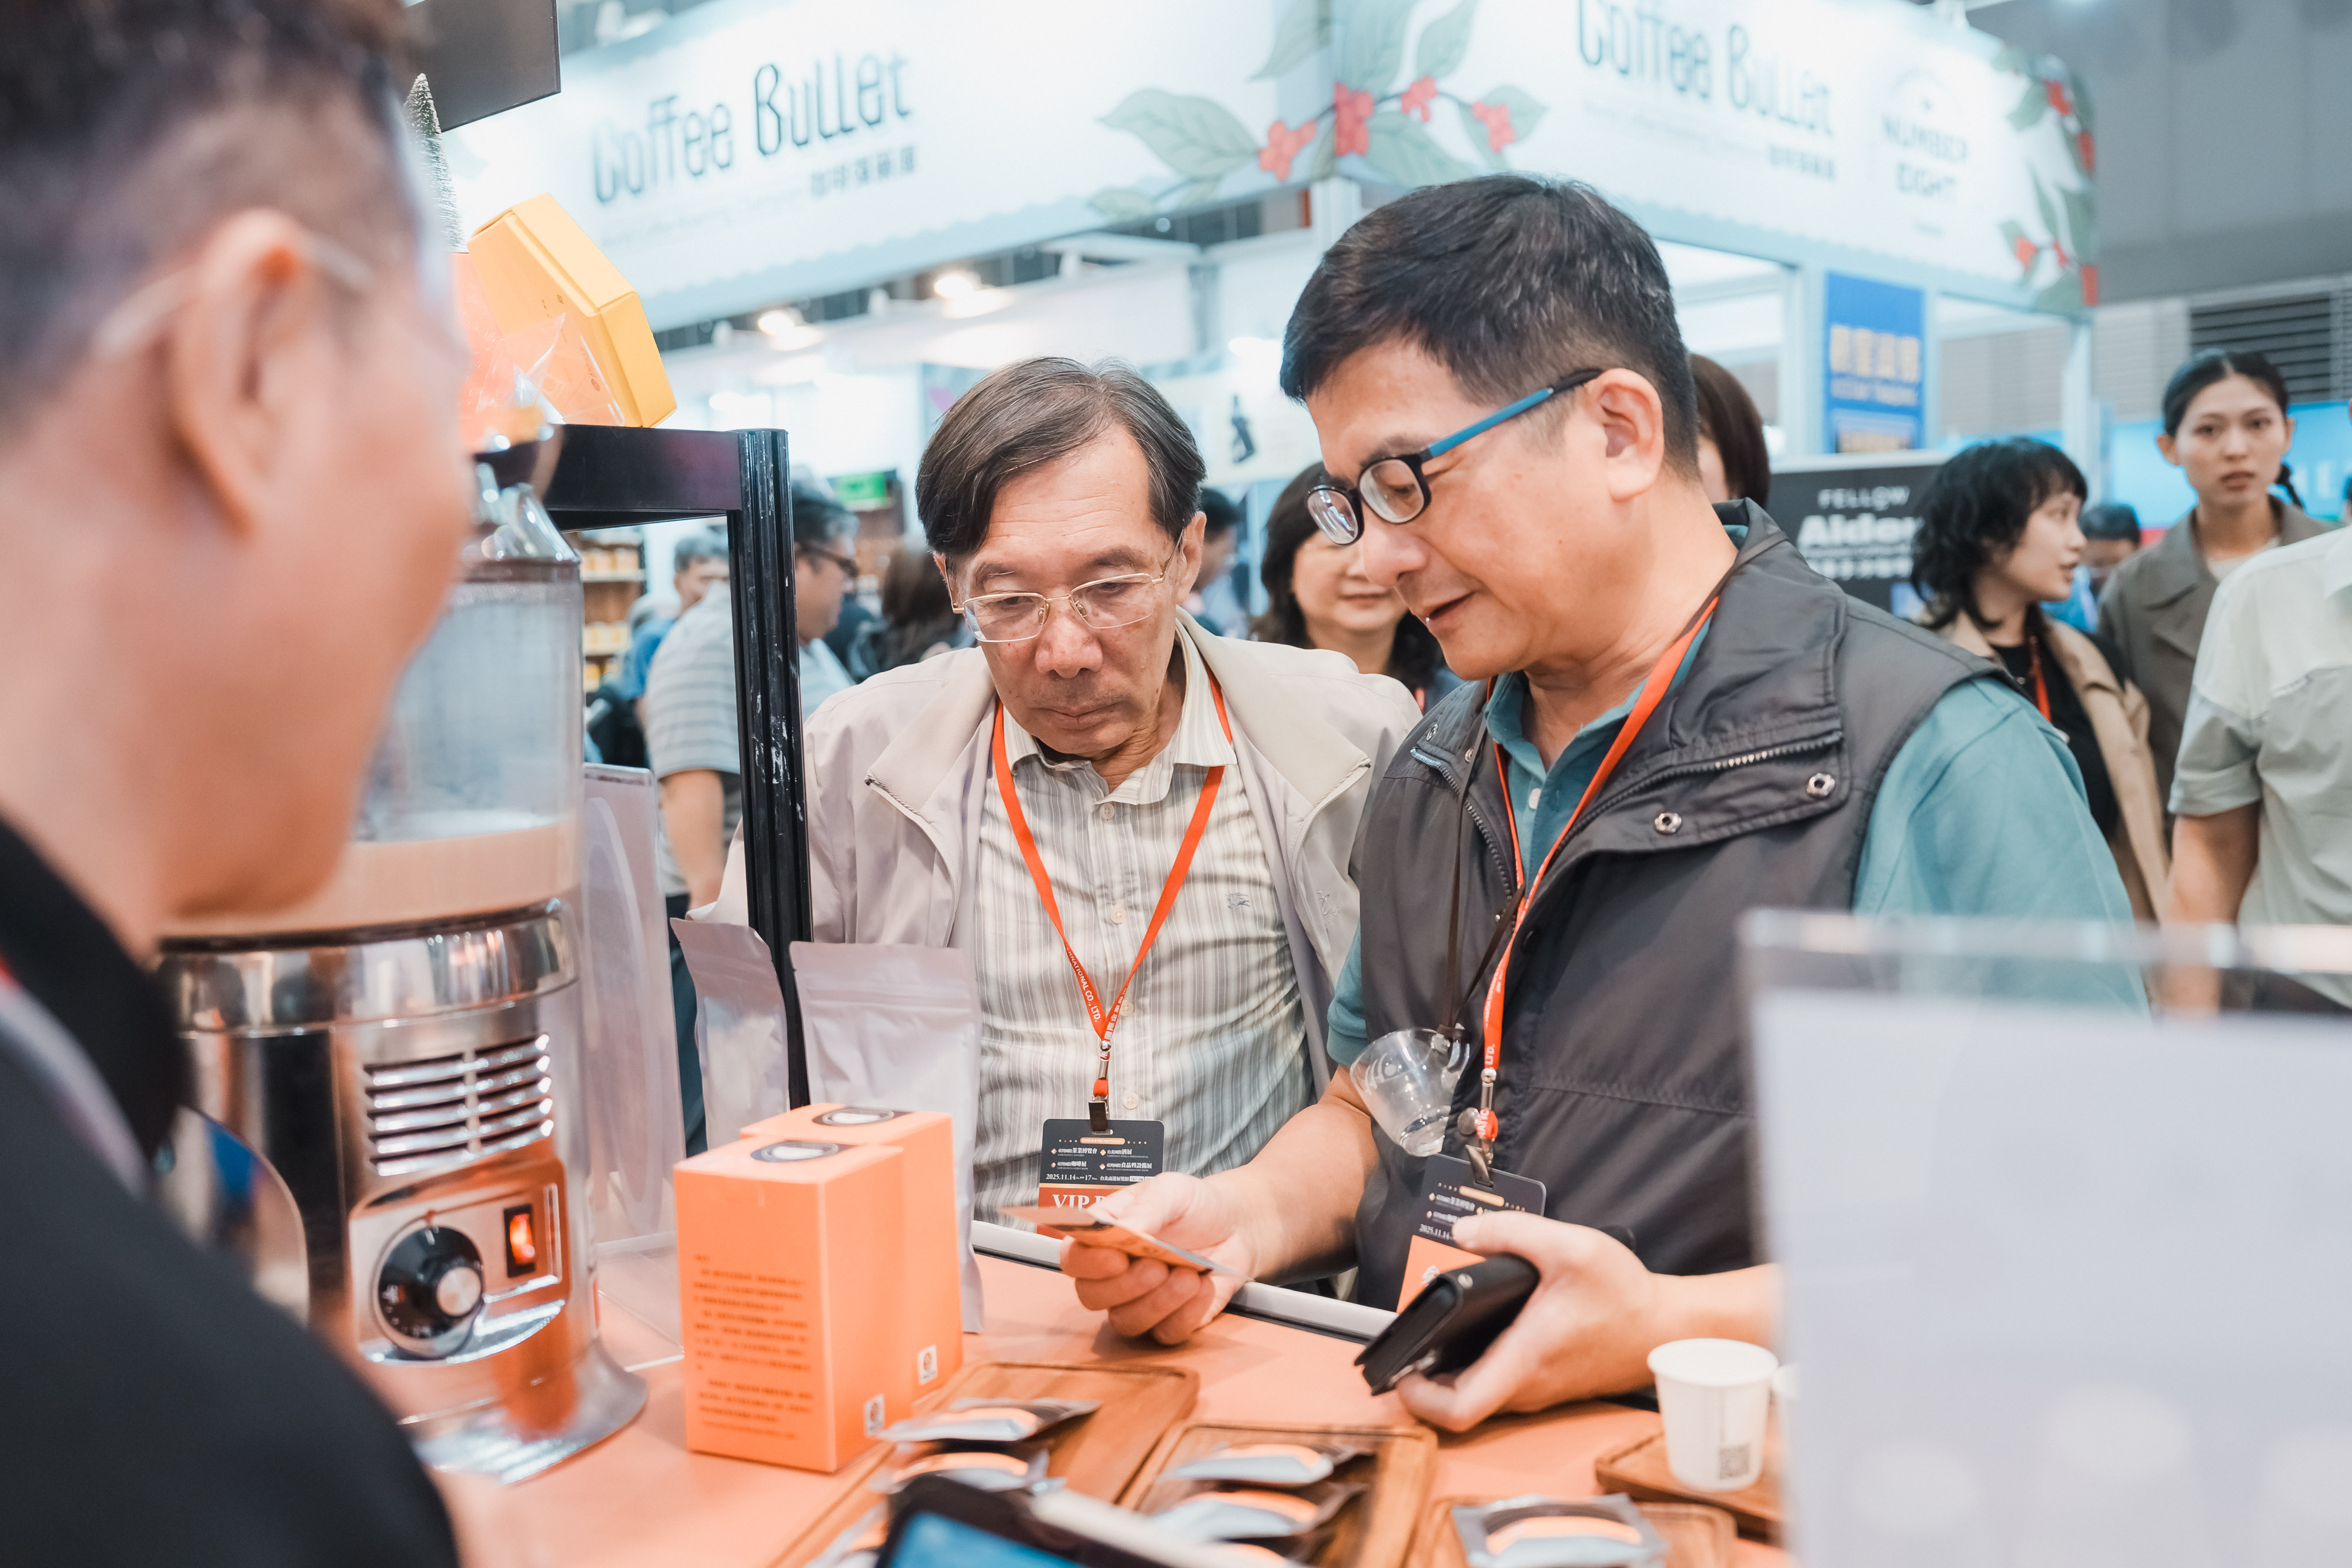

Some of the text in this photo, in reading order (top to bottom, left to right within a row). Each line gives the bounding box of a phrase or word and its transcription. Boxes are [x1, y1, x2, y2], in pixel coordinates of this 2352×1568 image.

[593, 53, 913, 203] Coffee Bullet
[1818, 486, 1910, 510] FELLOW
[1091, 1005, 1101, 1022] LTD.
[1052, 1194, 1090, 1211] VIP
